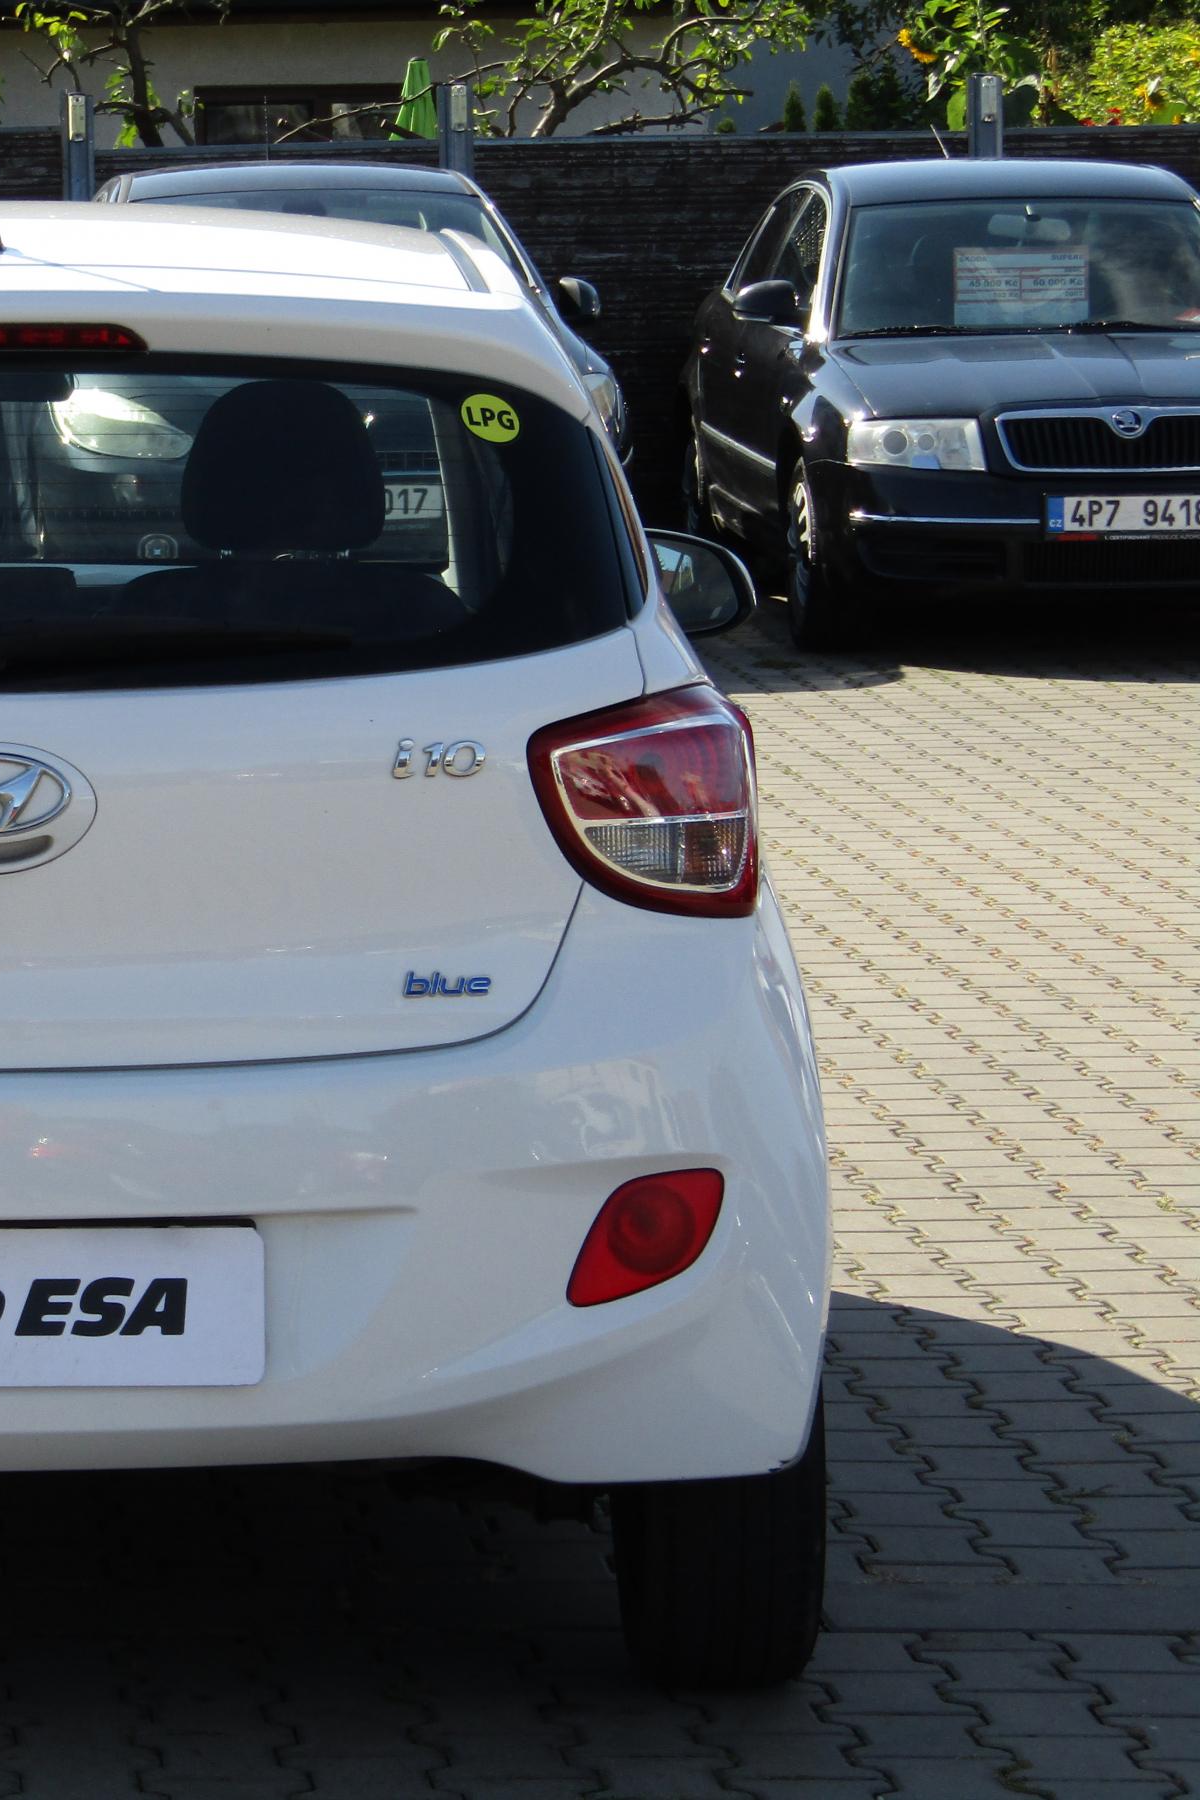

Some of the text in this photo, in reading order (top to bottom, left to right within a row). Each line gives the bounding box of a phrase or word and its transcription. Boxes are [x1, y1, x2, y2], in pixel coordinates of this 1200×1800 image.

[466, 406, 515, 431] LPG
[1049, 519, 1062, 528] CZ
[1071, 500, 1120, 527] 4P7
[391, 738, 486, 779] i10
[403, 971, 492, 998] blue
[14, 1276, 188, 1337] ESA
